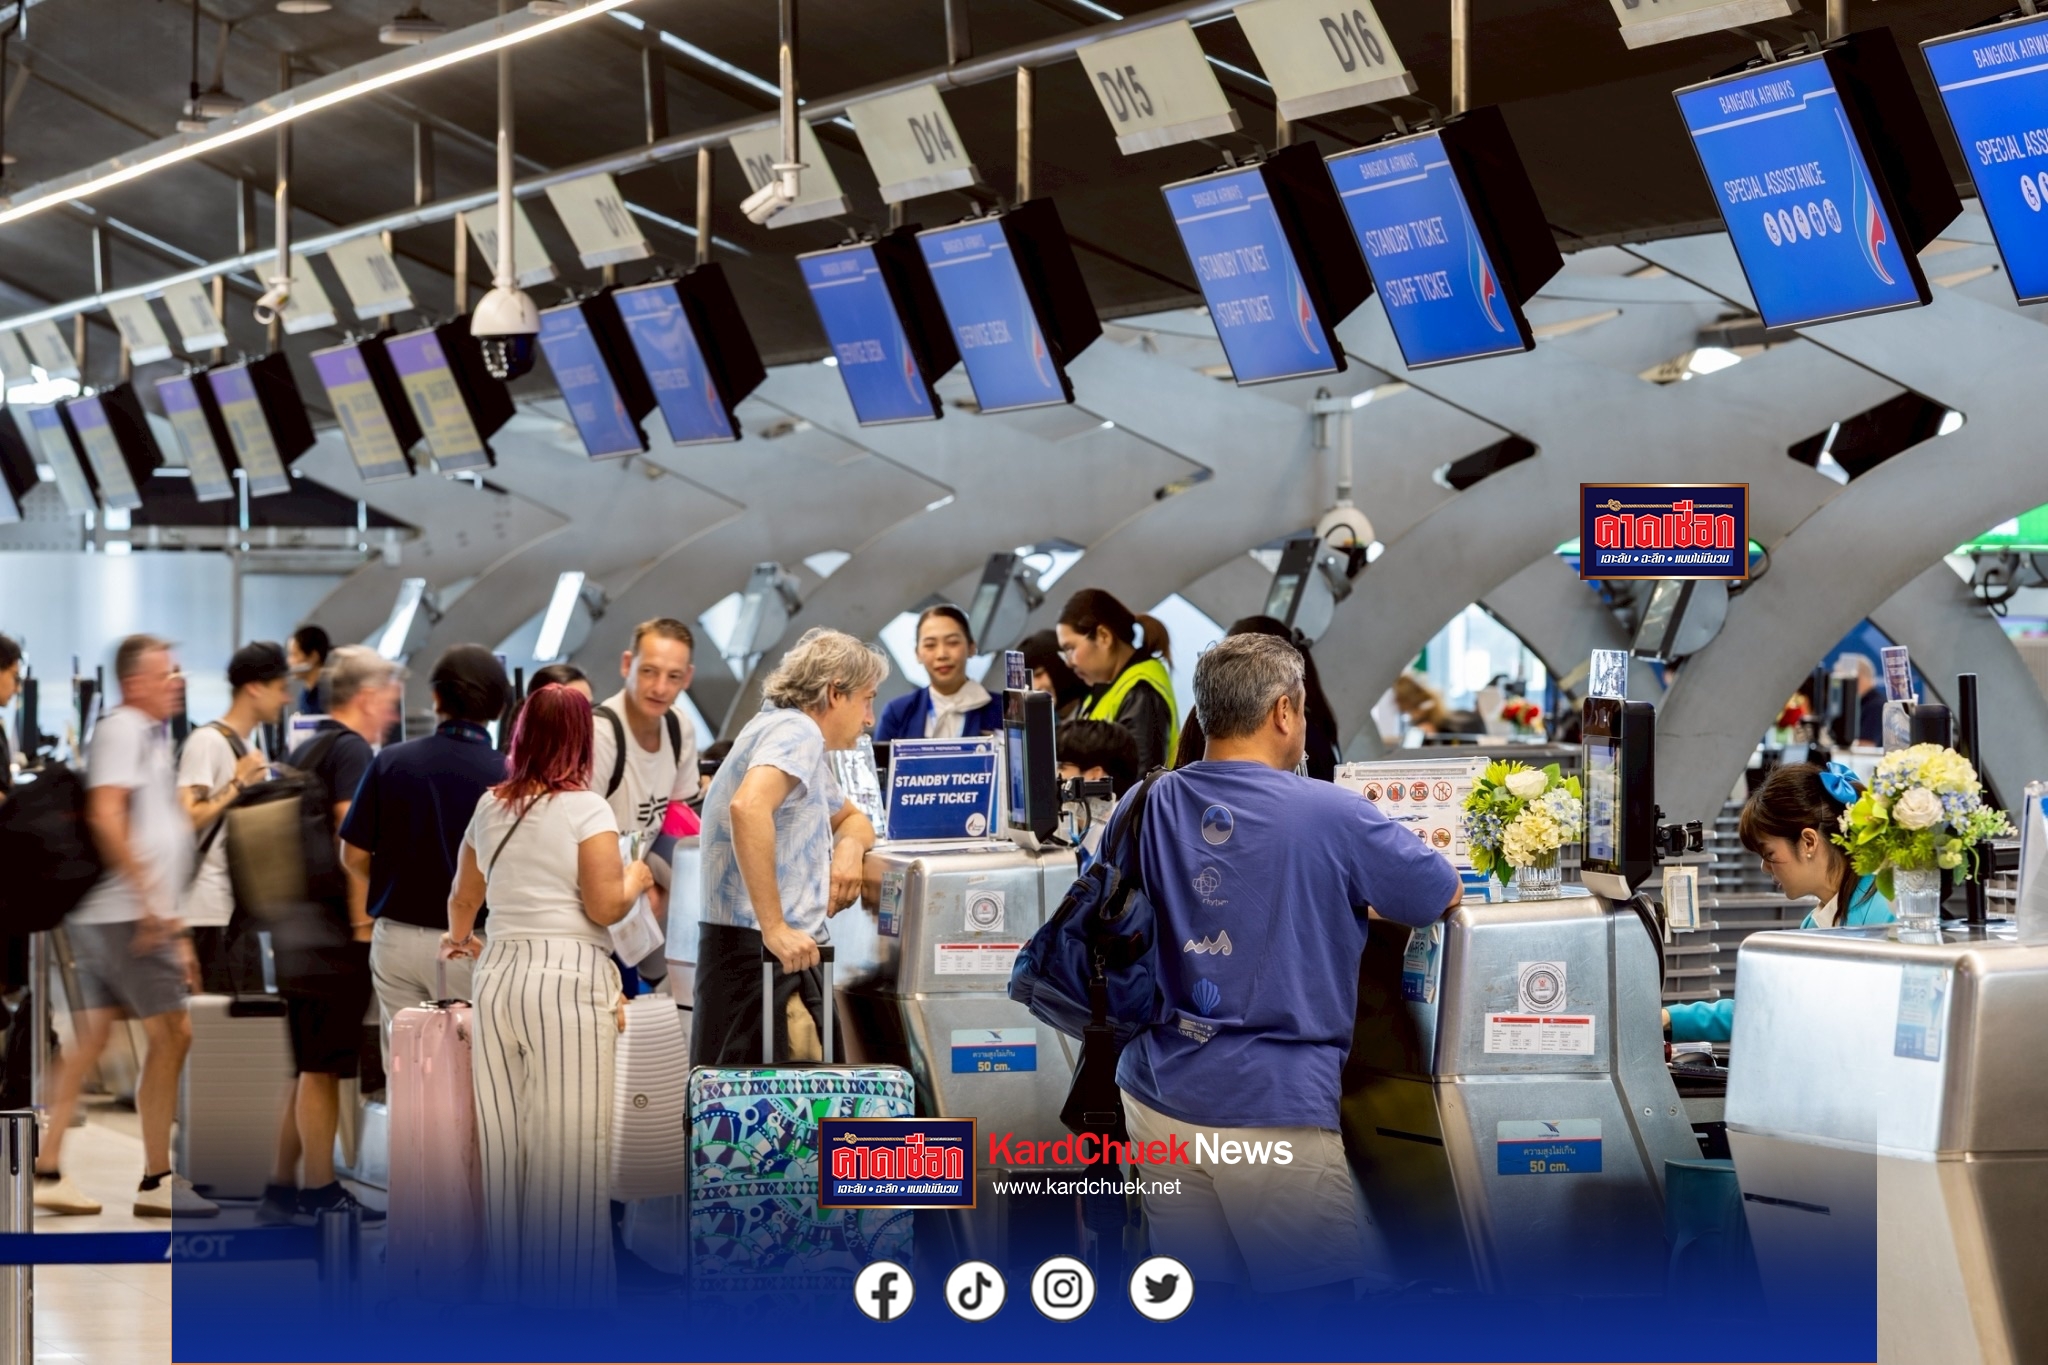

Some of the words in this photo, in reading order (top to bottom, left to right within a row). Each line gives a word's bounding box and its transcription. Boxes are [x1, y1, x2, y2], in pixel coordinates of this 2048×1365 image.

[1319, 9, 1386, 73] D16
[1972, 41, 2021, 69] BANGKOK
[1096, 65, 1154, 123] D15
[1718, 89, 1760, 114] BANGKOK
[1758, 79, 1796, 106] AIRWAYS
[907, 111, 957, 165] D14
[1975, 134, 2026, 166] SPECIAL
[1359, 160, 1392, 180] BANGKOK
[1389, 152, 1419, 175] AIRWAYS
[1723, 175, 1767, 204] SPECIAL
[1763, 161, 1826, 196] ASSISTANCE
[1365, 223, 1415, 258] STANDBY
[1409, 216, 1449, 249] TICKET
[1236, 244, 1271, 274] TICKET
[1385, 277, 1420, 308] STAFF
[1413, 270, 1454, 303] TICKET
[1240, 295, 1276, 324] TICKET
[895, 774, 951, 787] STANDBY
[951, 772, 992, 786] TICKET
[901, 793, 937, 806] STAFF
[938, 791, 979, 804] TICKET
[977, 1061, 992, 1072] 50
[993, 1063, 1011, 1072] cm.
[1529, 1160, 1547, 1173] 50
[1549, 1163, 1570, 1173] cm.
[163, 1234, 236, 1259] AOT
